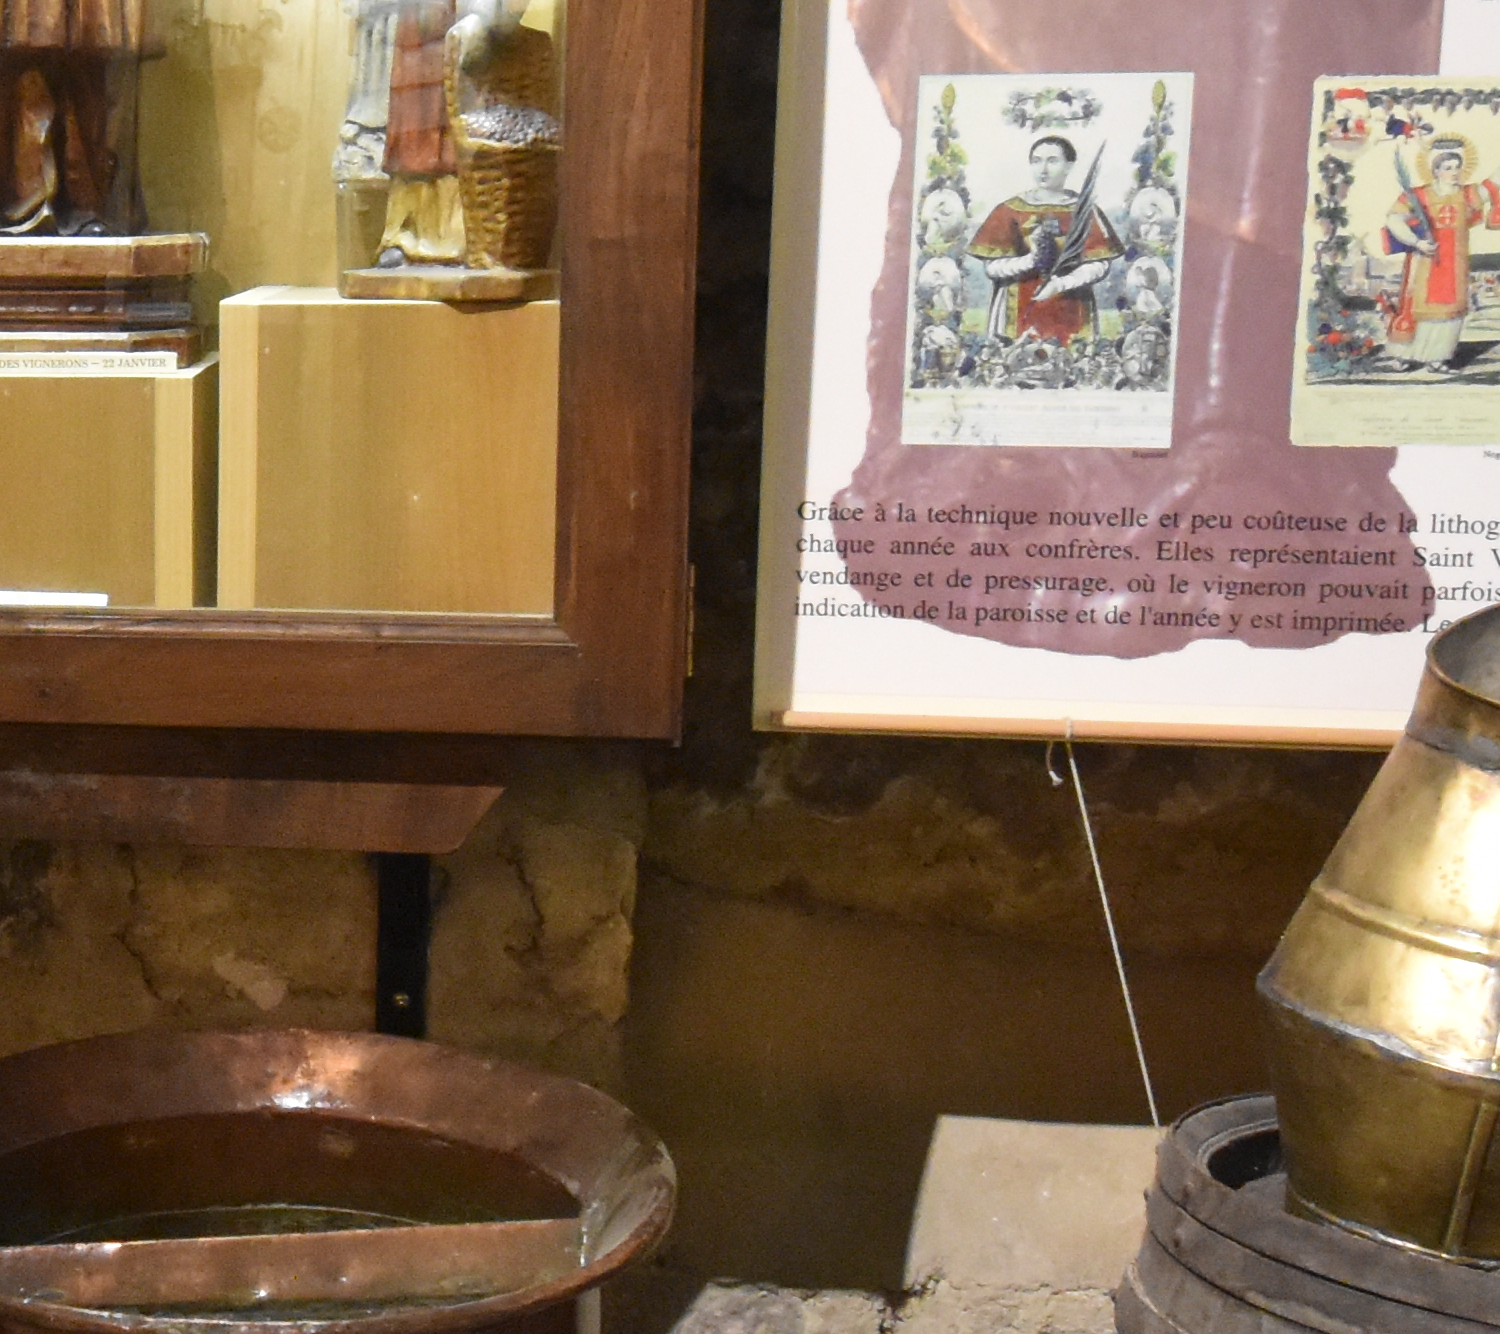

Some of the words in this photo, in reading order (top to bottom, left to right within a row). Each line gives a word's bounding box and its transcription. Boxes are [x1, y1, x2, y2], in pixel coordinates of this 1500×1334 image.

[22, 358, 89, 369] VIGNERONS
[102, 358, 115, 368] 22
[117, 358, 167, 368] JANVIER
